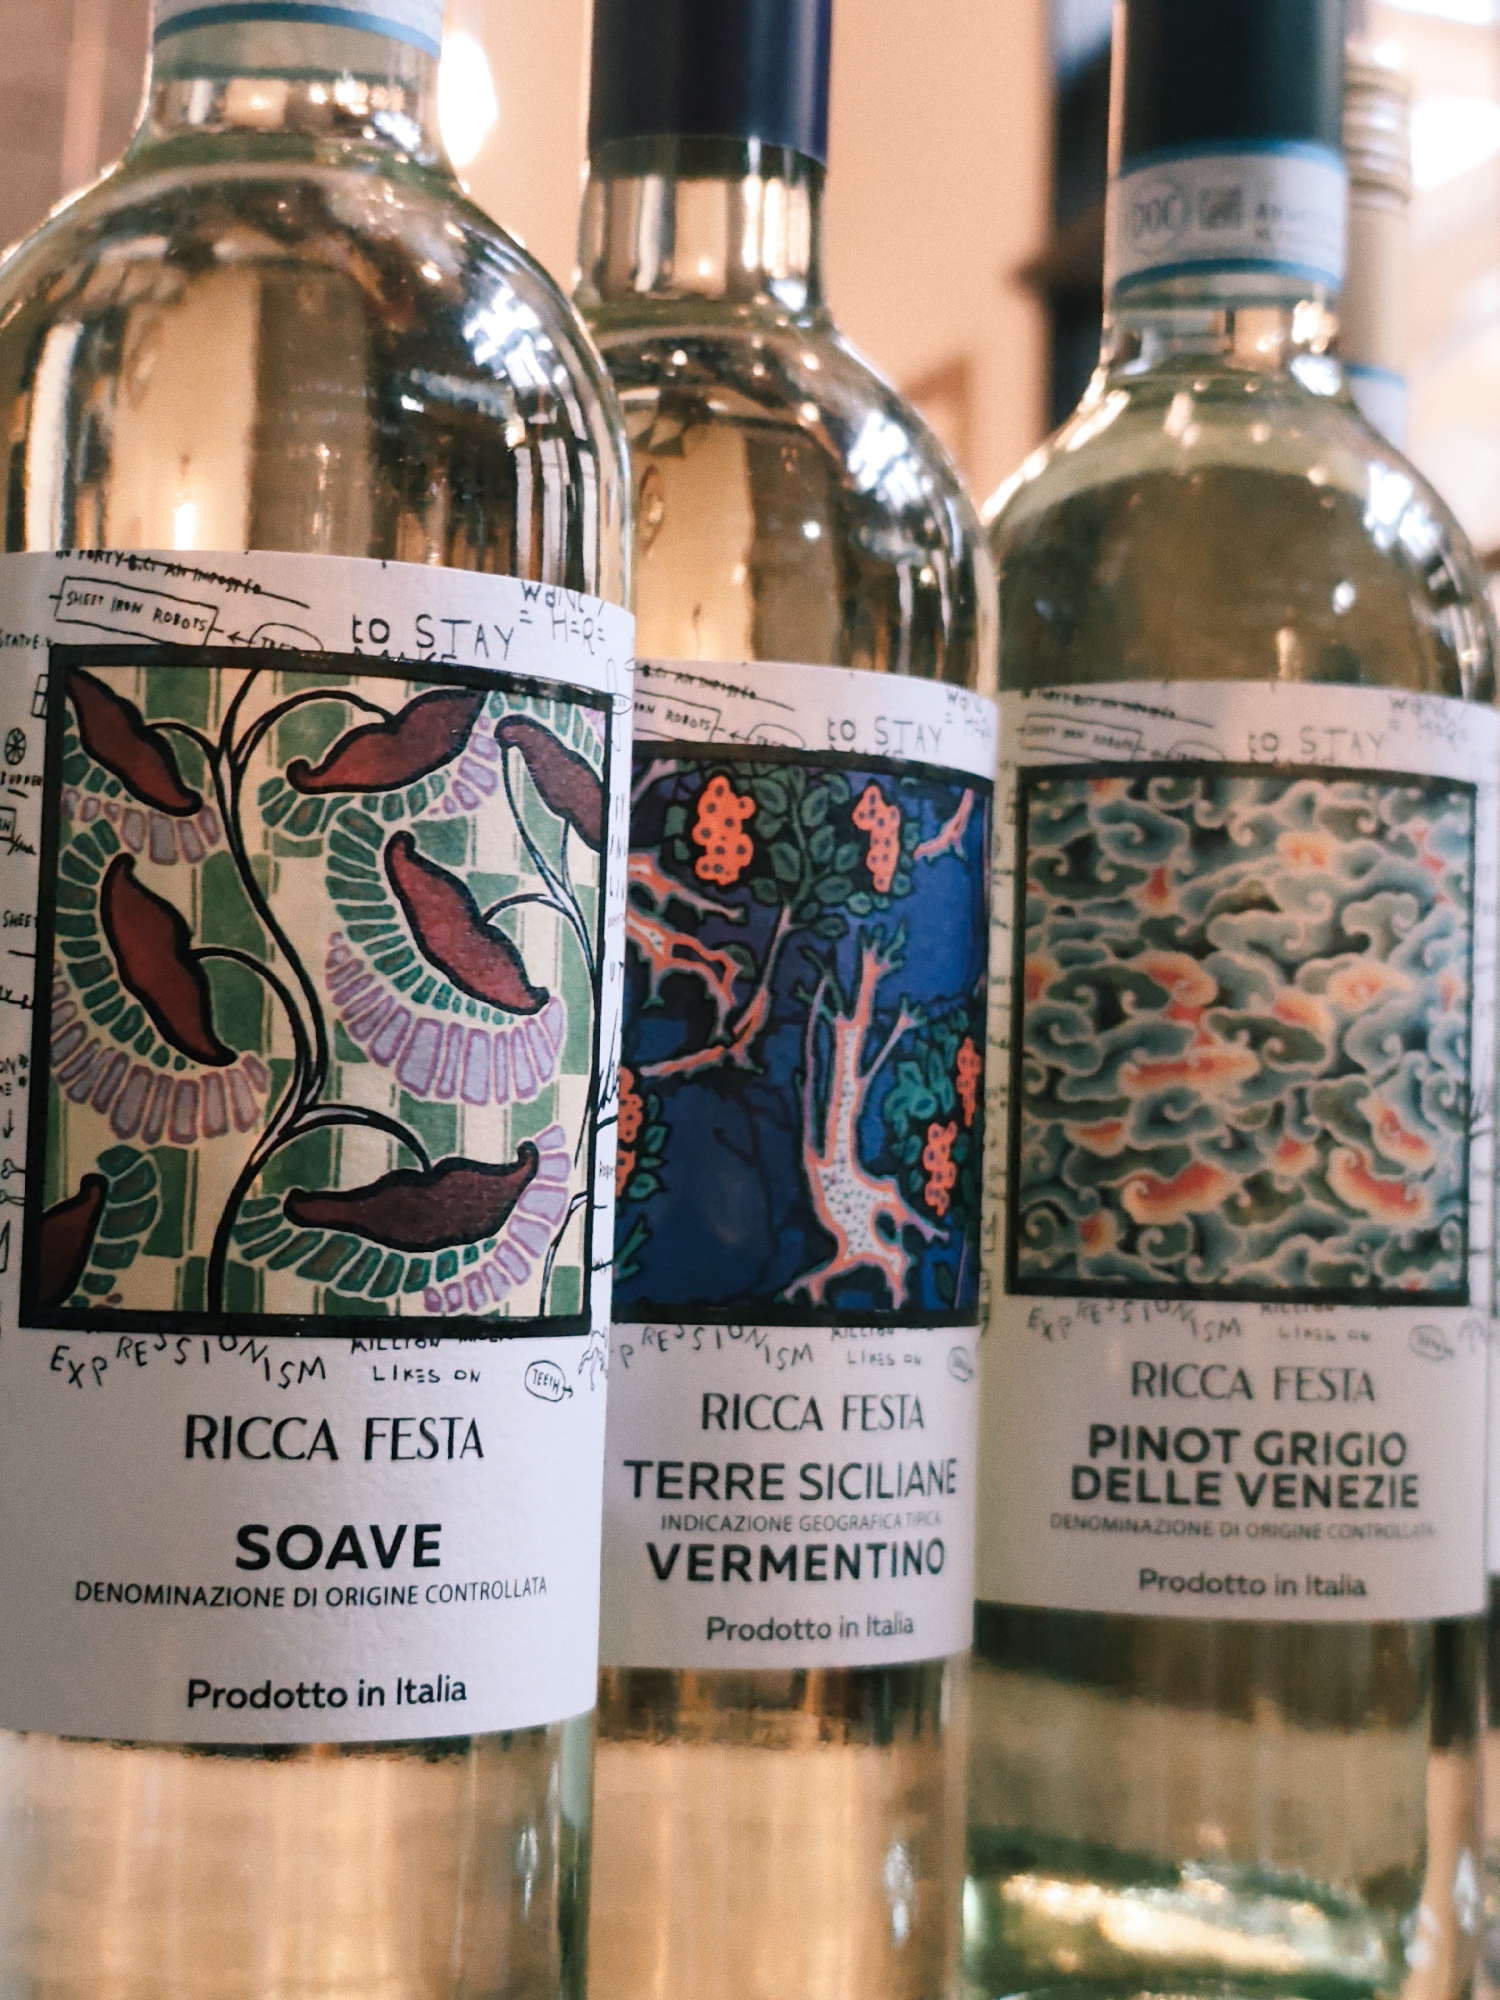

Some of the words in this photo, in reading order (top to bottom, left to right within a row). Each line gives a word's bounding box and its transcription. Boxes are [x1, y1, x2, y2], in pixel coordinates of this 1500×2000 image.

[416, 614, 514, 660] STAY
[875, 716, 942, 754] STAY
[1131, 1361, 1252, 1400] RICCA
[1274, 1365, 1375, 1402] FESTA
[701, 1393, 823, 1432] RICCA
[842, 1393, 925, 1431] FESTA
[185, 1414, 338, 1460] RICCA
[364, 1417, 485, 1460] FESTA
[1089, 1423, 1240, 1463] PINOT
[1253, 1430, 1407, 1467] GRIGIO
[623, 1460, 785, 1500] TERRE
[799, 1458, 957, 1500] SICILIANE
[1071, 1465, 1221, 1506] DELLE
[1236, 1472, 1420, 1508] VENEZIE
[661, 1514, 792, 1532] INDICAZIONE
[799, 1513, 901, 1531] GEOGRAFICA
[1050, 1512, 1213, 1537] DENOMINAZIONE
[1220, 1522, 1240, 1537] DI
[1246, 1522, 1321, 1540] ORIGINE
[236, 1524, 442, 1571] SOAVE
[646, 1538, 945, 1582] VERMENTINO
[75, 1580, 284, 1608] DENOMINAZIONE
[294, 1587, 318, 1608] DI
[326, 1585, 418, 1607] ORIGINE
[425, 1576, 547, 1603] CONTROLLATA
[1139, 1567, 1266, 1596] Prodotto
[1274, 1572, 1297, 1596] in
[1307, 1573, 1366, 1597] Italia
[707, 1616, 831, 1641] Prodotto
[840, 1616, 859, 1638] in
[867, 1615, 914, 1637] Italia
[187, 1679, 348, 1710] Prodotto
[358, 1679, 385, 1707] in
[396, 1675, 467, 1705] Italia
